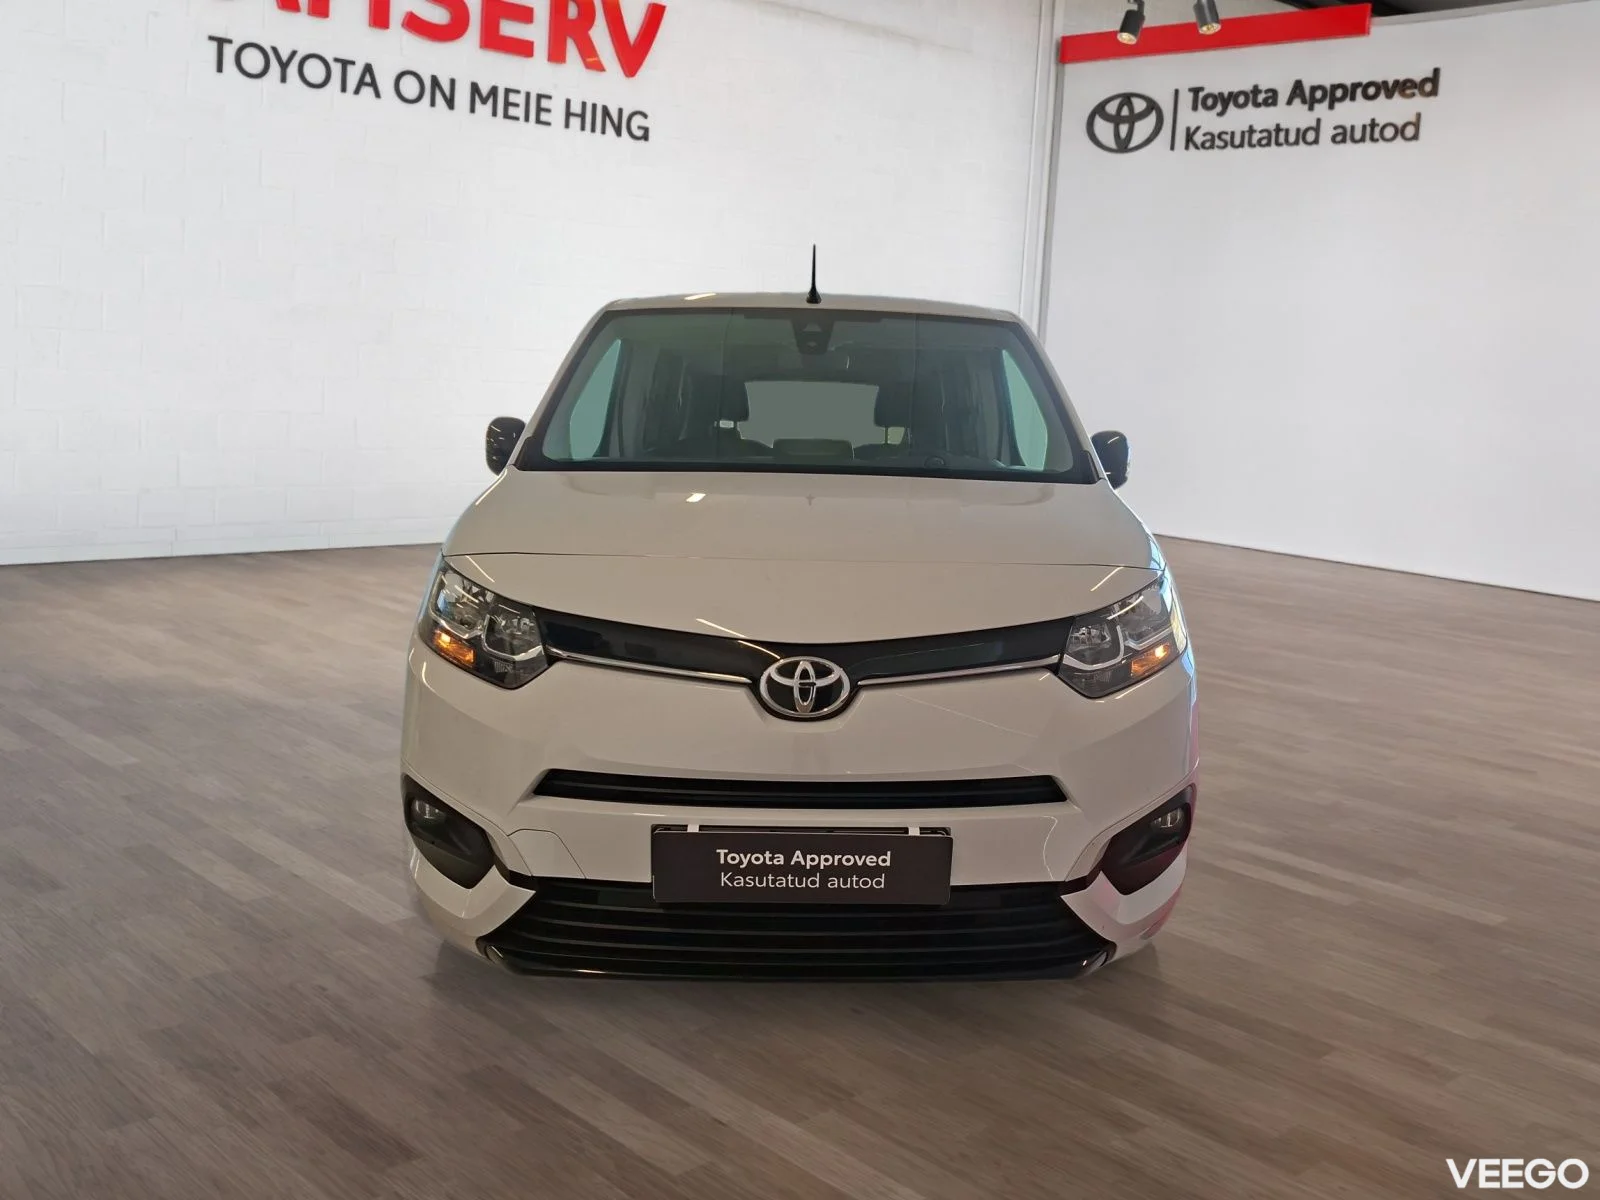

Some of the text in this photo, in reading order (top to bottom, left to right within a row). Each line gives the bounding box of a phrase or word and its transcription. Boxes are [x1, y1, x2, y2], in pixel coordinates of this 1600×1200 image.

[276, 0, 667, 79] SERV
[207, 35, 650, 142] TOYOTA ON MEIE HING
[1188, 67, 1441, 117] Toyota Approved
[1183, 112, 1422, 151] Kasutatud autod
[716, 849, 891, 870] Toyota Approved
[720, 871, 885, 889] Kasutatud autod
